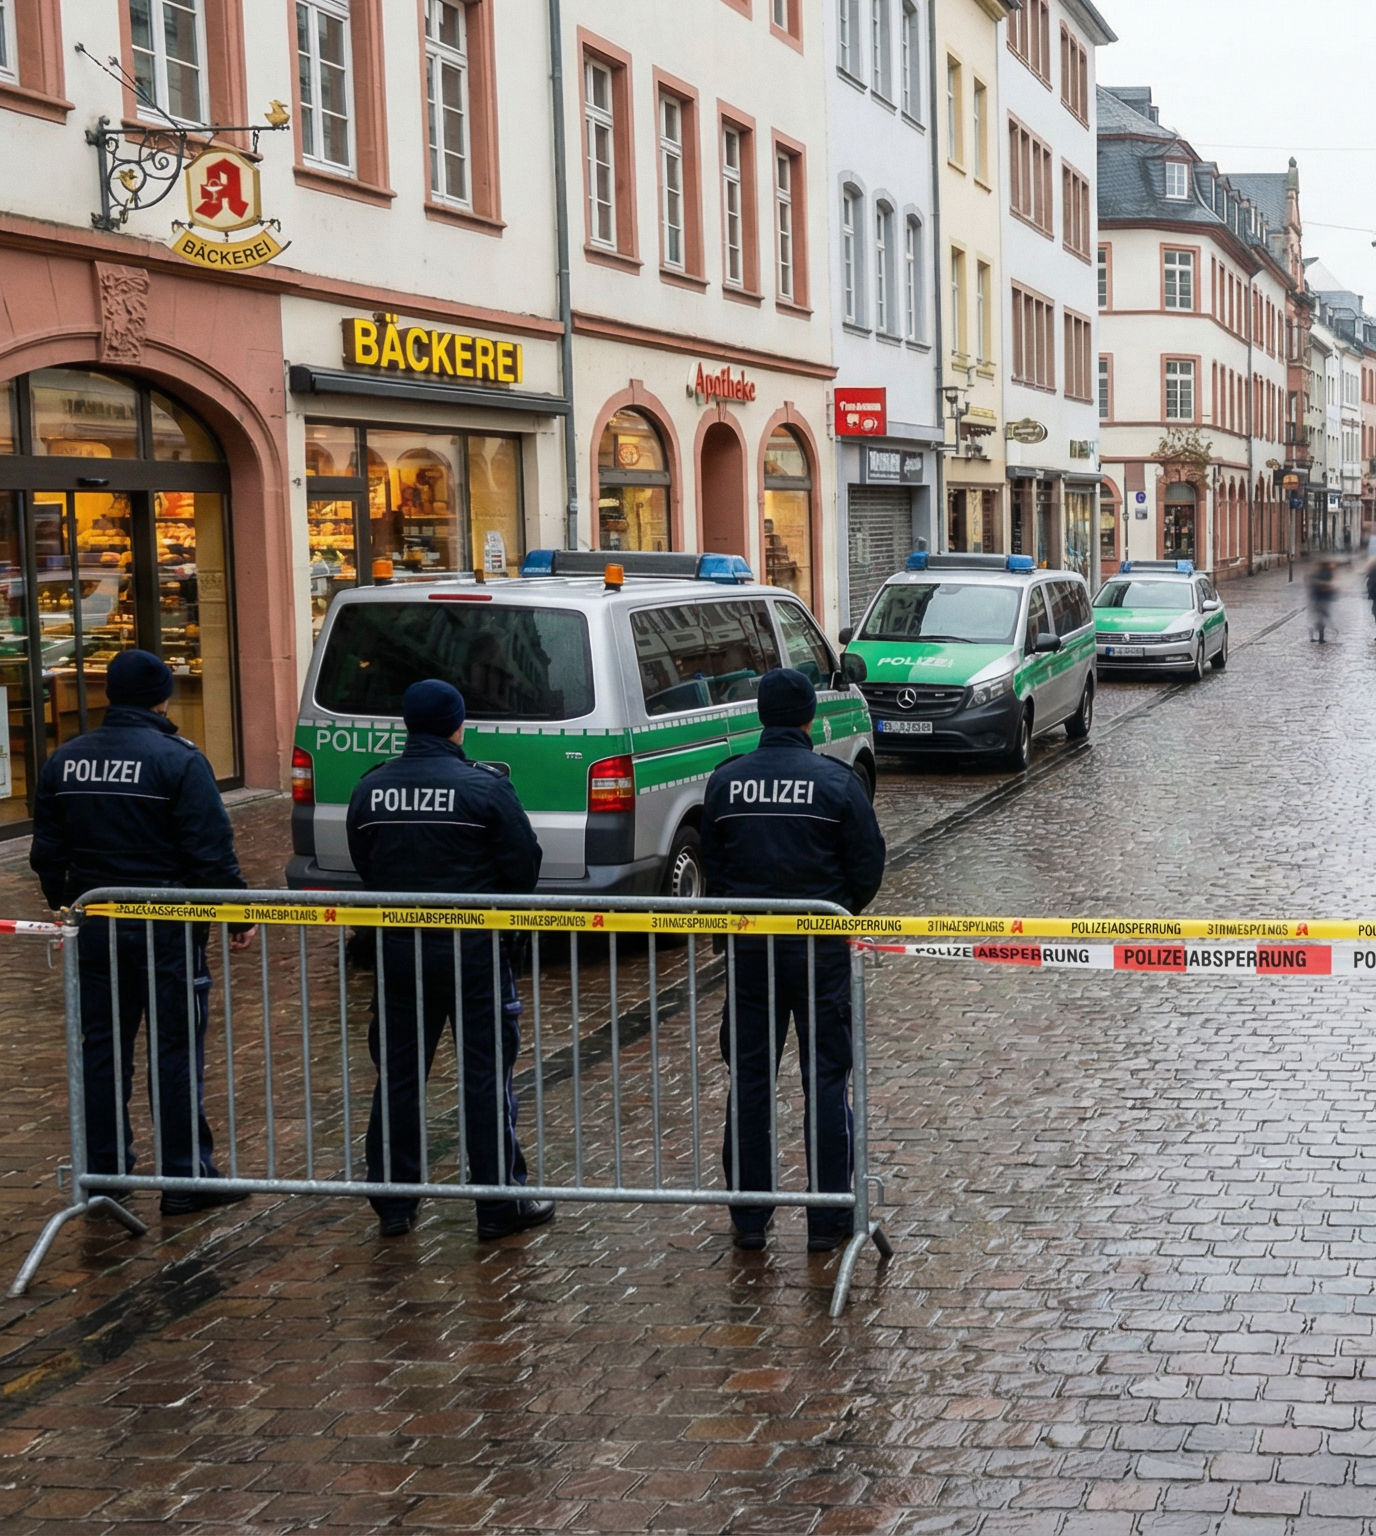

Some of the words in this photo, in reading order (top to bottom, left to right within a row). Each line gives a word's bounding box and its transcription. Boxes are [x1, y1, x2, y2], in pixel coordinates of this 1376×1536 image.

[182, 239, 271, 265] BÄCKEREI
[354, 313, 523, 383] BÄCKEREI
[695, 361, 757, 404] Apotheke
[877, 656, 955, 669] POLIZEI
[63, 758, 142, 783] POLIZEI
[371, 787, 455, 812] POLIZEI
[729, 780, 814, 804] POLIZEI
[1124, 949, 1307, 968] POLIZEIABSPERRUNG
